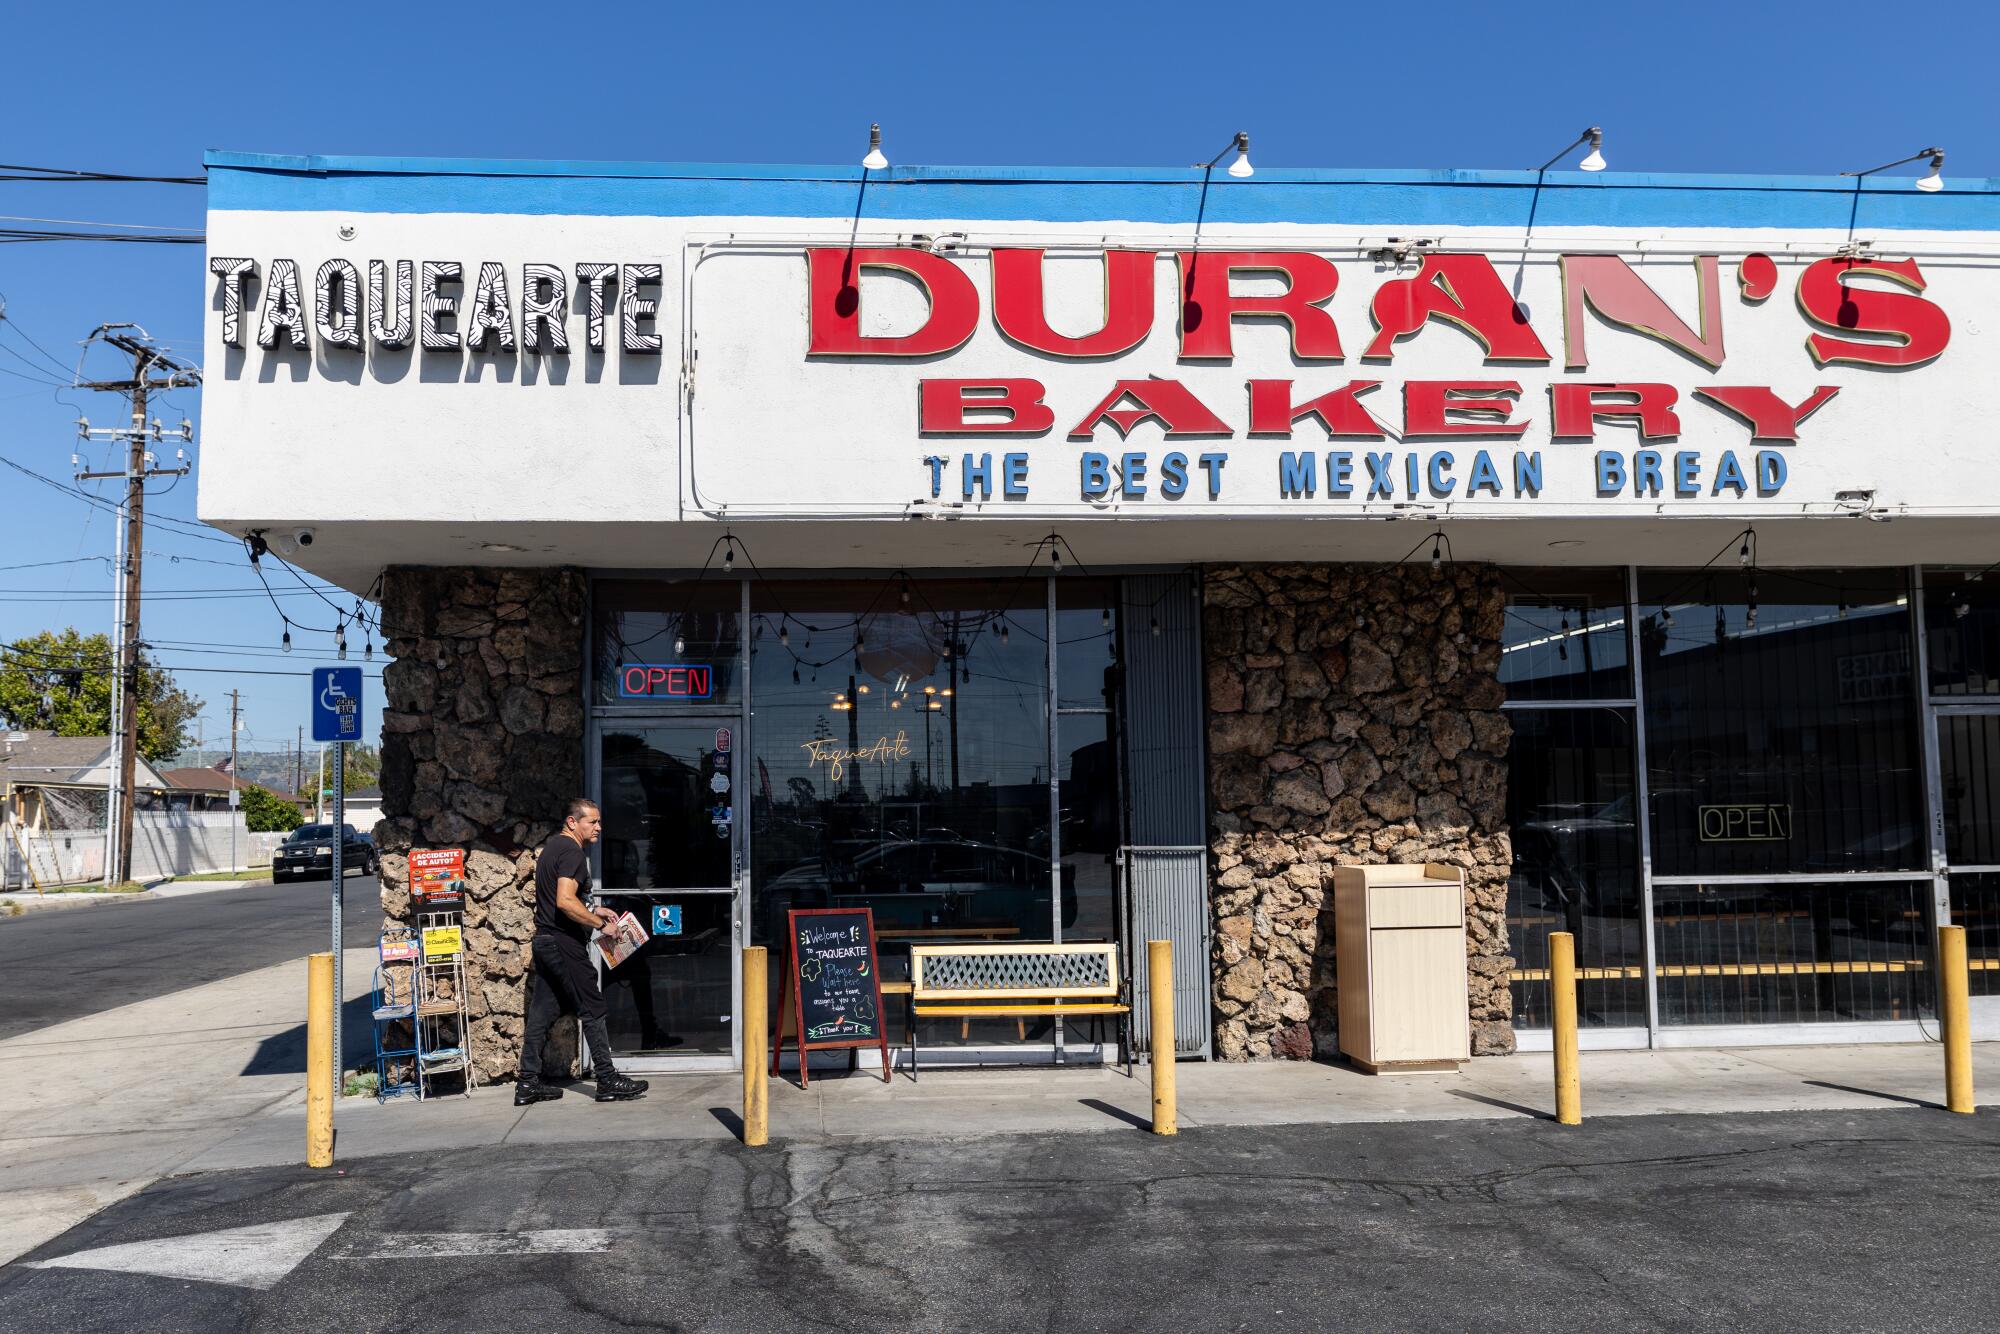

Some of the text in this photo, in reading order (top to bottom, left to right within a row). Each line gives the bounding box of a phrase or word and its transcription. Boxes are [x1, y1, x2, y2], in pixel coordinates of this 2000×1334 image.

[210, 257, 663, 354] TAQUEARTE
[805, 248, 1952, 369] DURAN'S
[918, 376, 1842, 441] BAKERY
[924, 450, 1788, 498] THE BEST MEXICAN BREAD
[624, 667, 708, 696] OPEN
[800, 730, 911, 781] TaqueArte
[1704, 808, 1786, 837] OPEN
[412, 851, 459, 862] ¿ACCIDENTE
[816, 946, 867, 960] TAQUEARTE
[825, 963, 853, 977] Please
[844, 978, 861, 987] here
